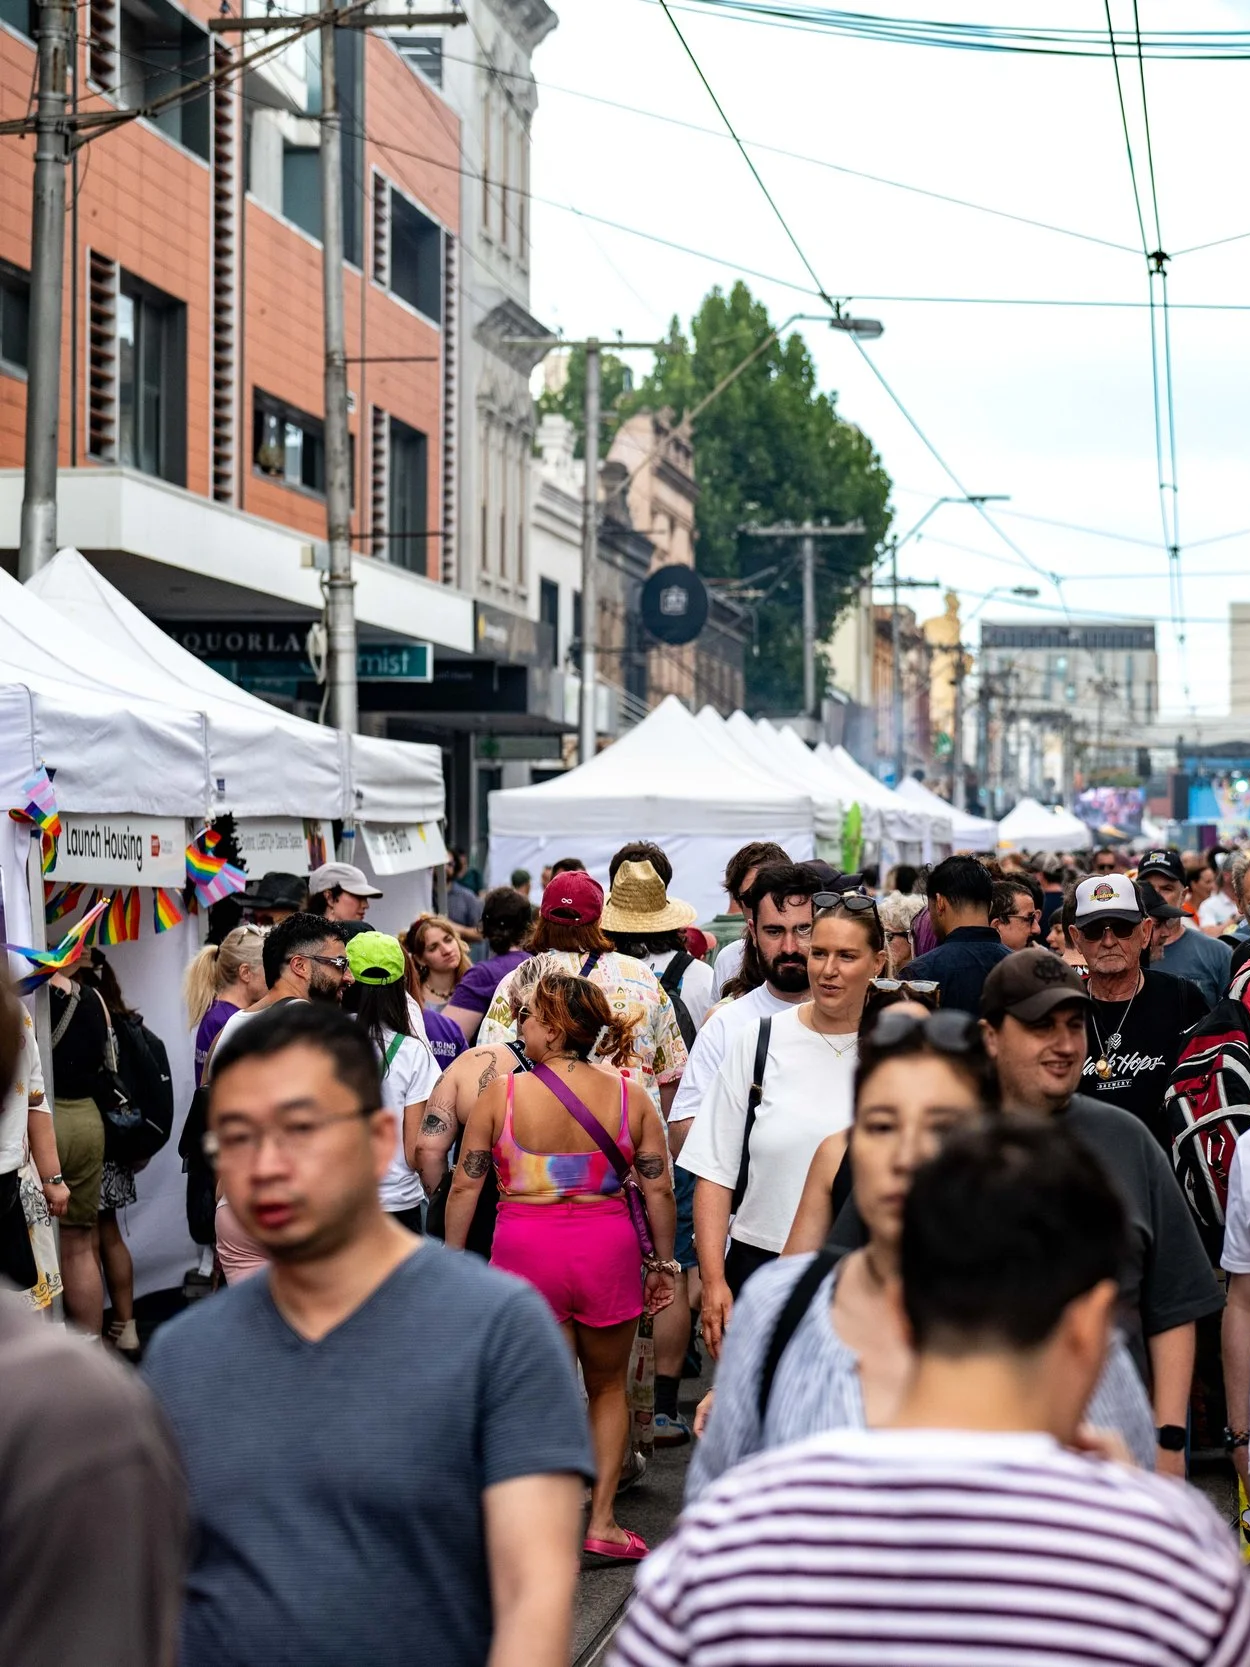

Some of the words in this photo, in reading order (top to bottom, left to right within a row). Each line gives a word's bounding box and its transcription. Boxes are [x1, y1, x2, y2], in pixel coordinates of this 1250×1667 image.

[171, 631, 309, 655] QUORLA
[357, 649, 411, 674] mist
[66, 821, 101, 858] Launch
[104, 826, 143, 873] Housing
[433, 1048, 456, 1057] SSNESS
[443, 1042, 456, 1050] END
[1116, 1051, 1166, 1077] Hops
[1099, 1080, 1130, 1089] BREWERY
